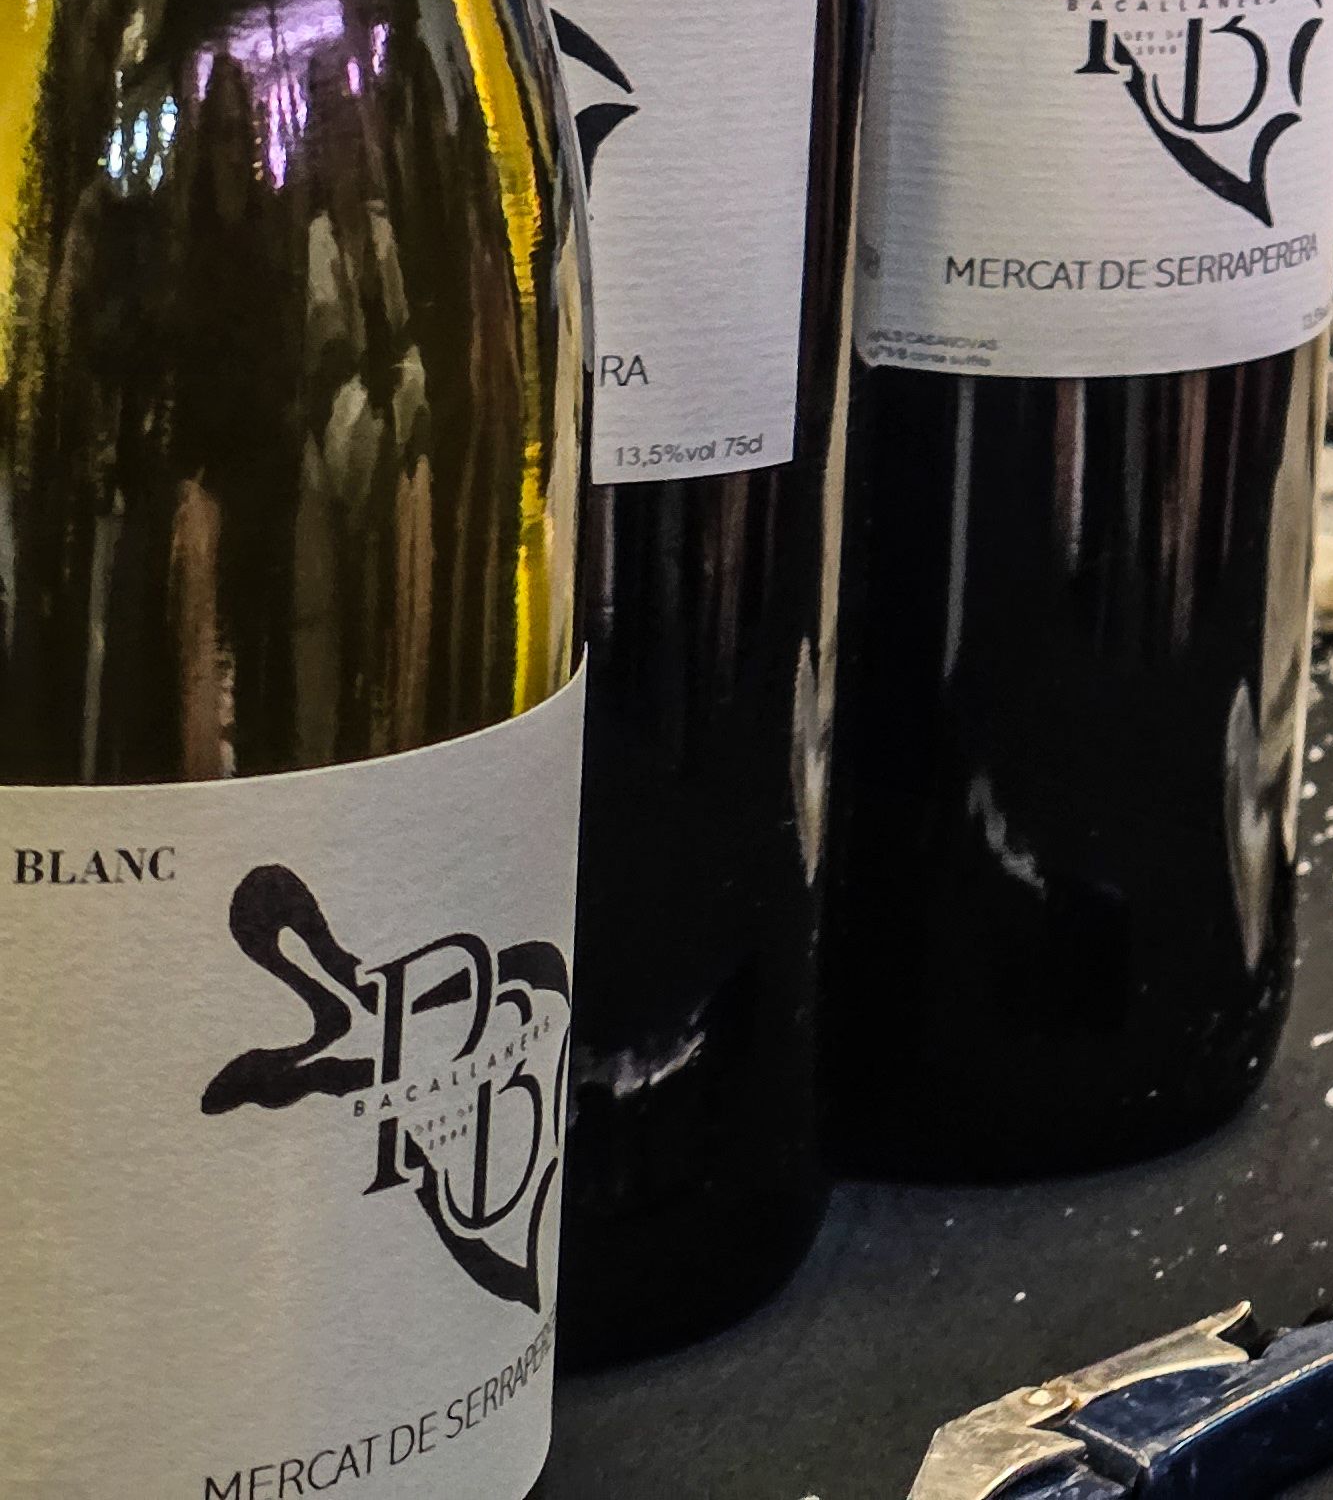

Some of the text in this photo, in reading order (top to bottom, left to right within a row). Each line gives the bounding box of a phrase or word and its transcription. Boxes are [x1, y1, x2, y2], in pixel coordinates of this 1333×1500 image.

[945, 232, 1318, 290] MERCAT DE SERRAPERERA
[13, 846, 175, 885] BLANC
[353, 1015, 550, 1117] BACALLANERS
[204, 1434, 382, 1500] MERCAT
[389, 1411, 437, 1466] DE
